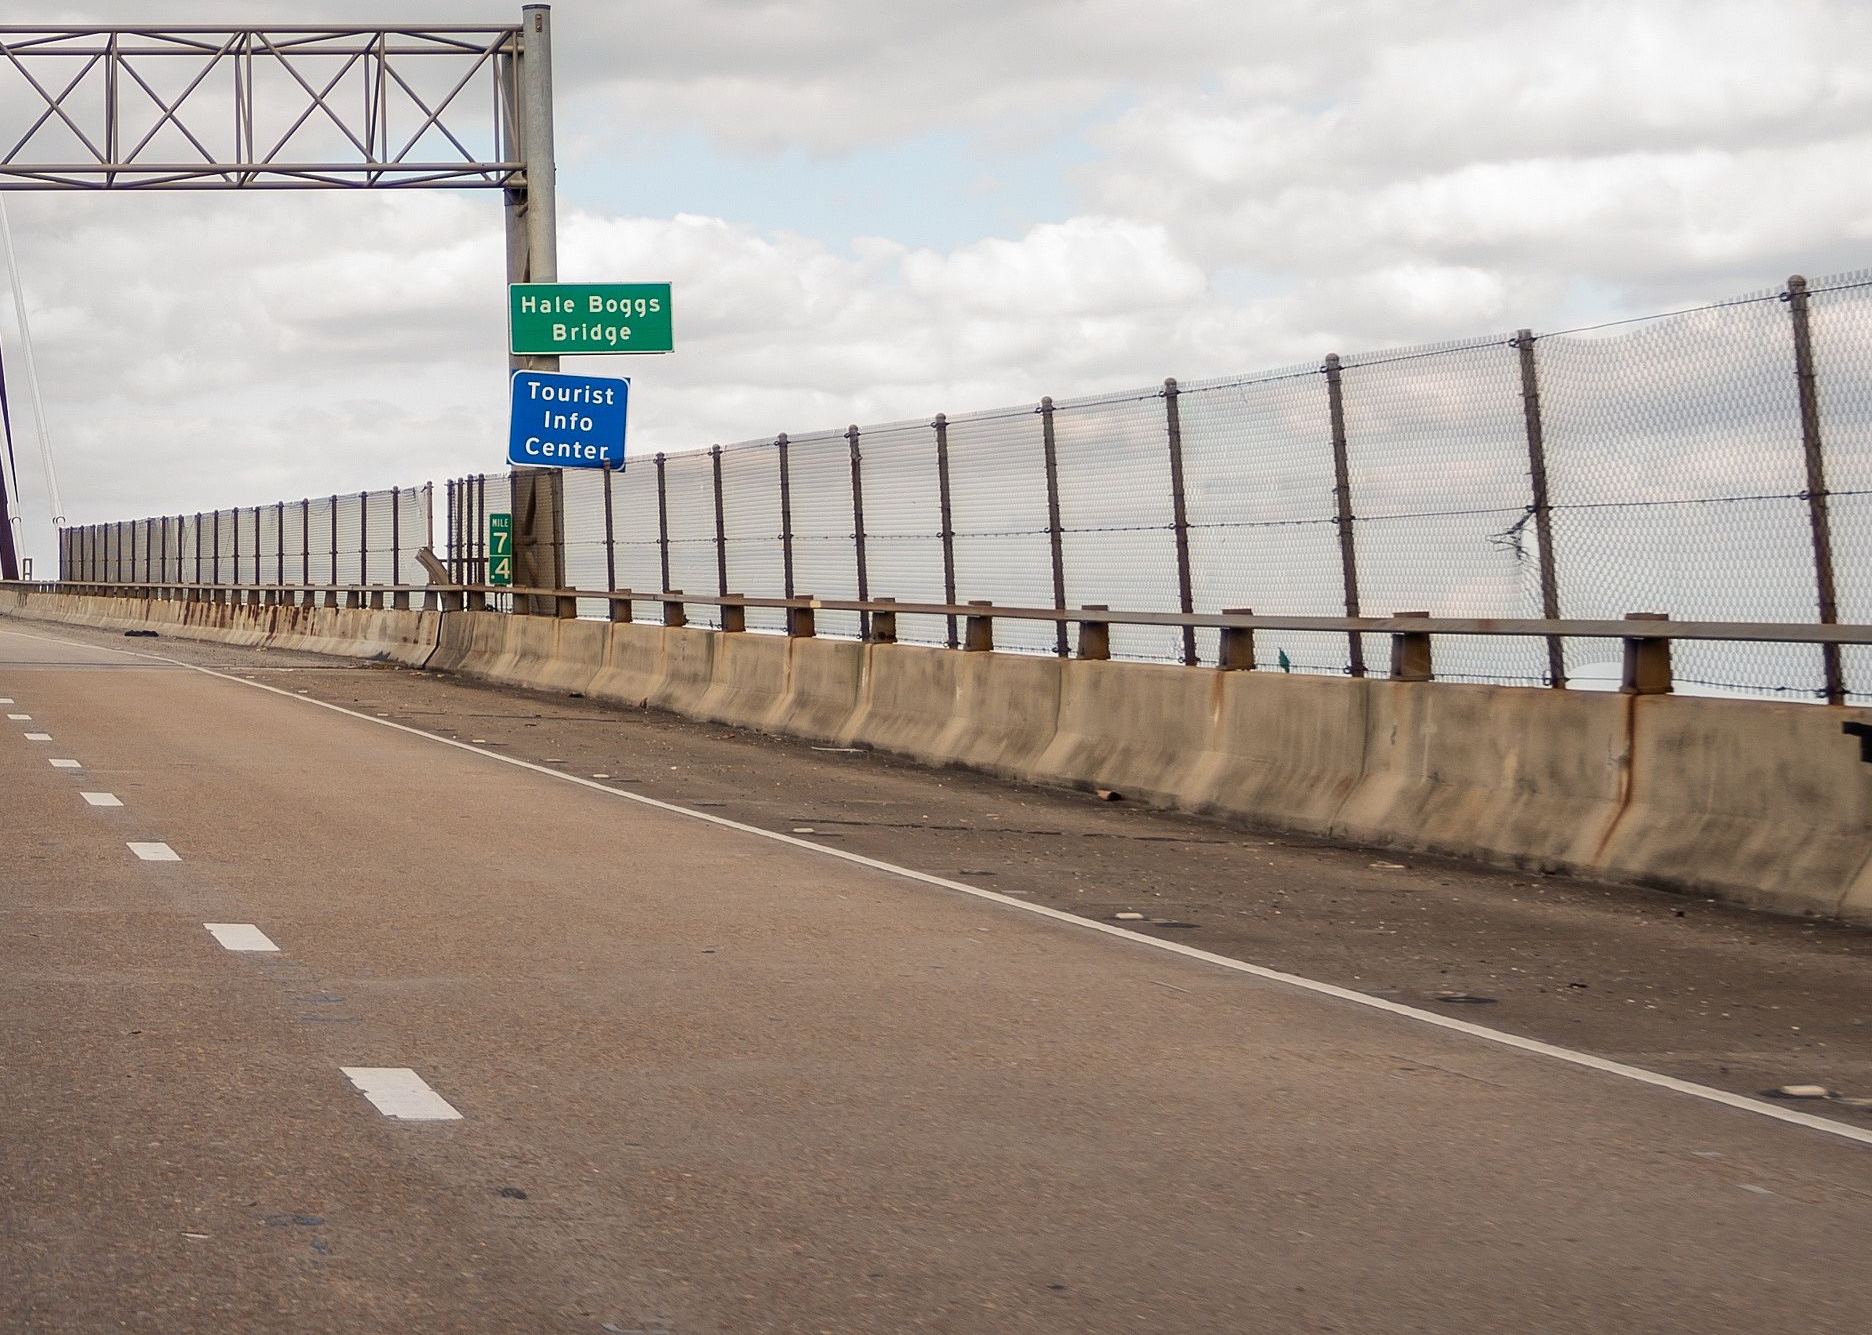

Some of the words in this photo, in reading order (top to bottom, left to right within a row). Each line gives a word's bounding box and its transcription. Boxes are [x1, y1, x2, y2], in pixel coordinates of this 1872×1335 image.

[521, 295, 576, 314] Hale
[588, 295, 661, 318] Boggs
[552, 323, 632, 346] Bridge
[528, 381, 615, 405] Tourist
[544, 410, 593, 432] Info
[525, 437, 609, 461] Center
[492, 518, 509, 527] MILE
[493, 531, 508, 554] 7
